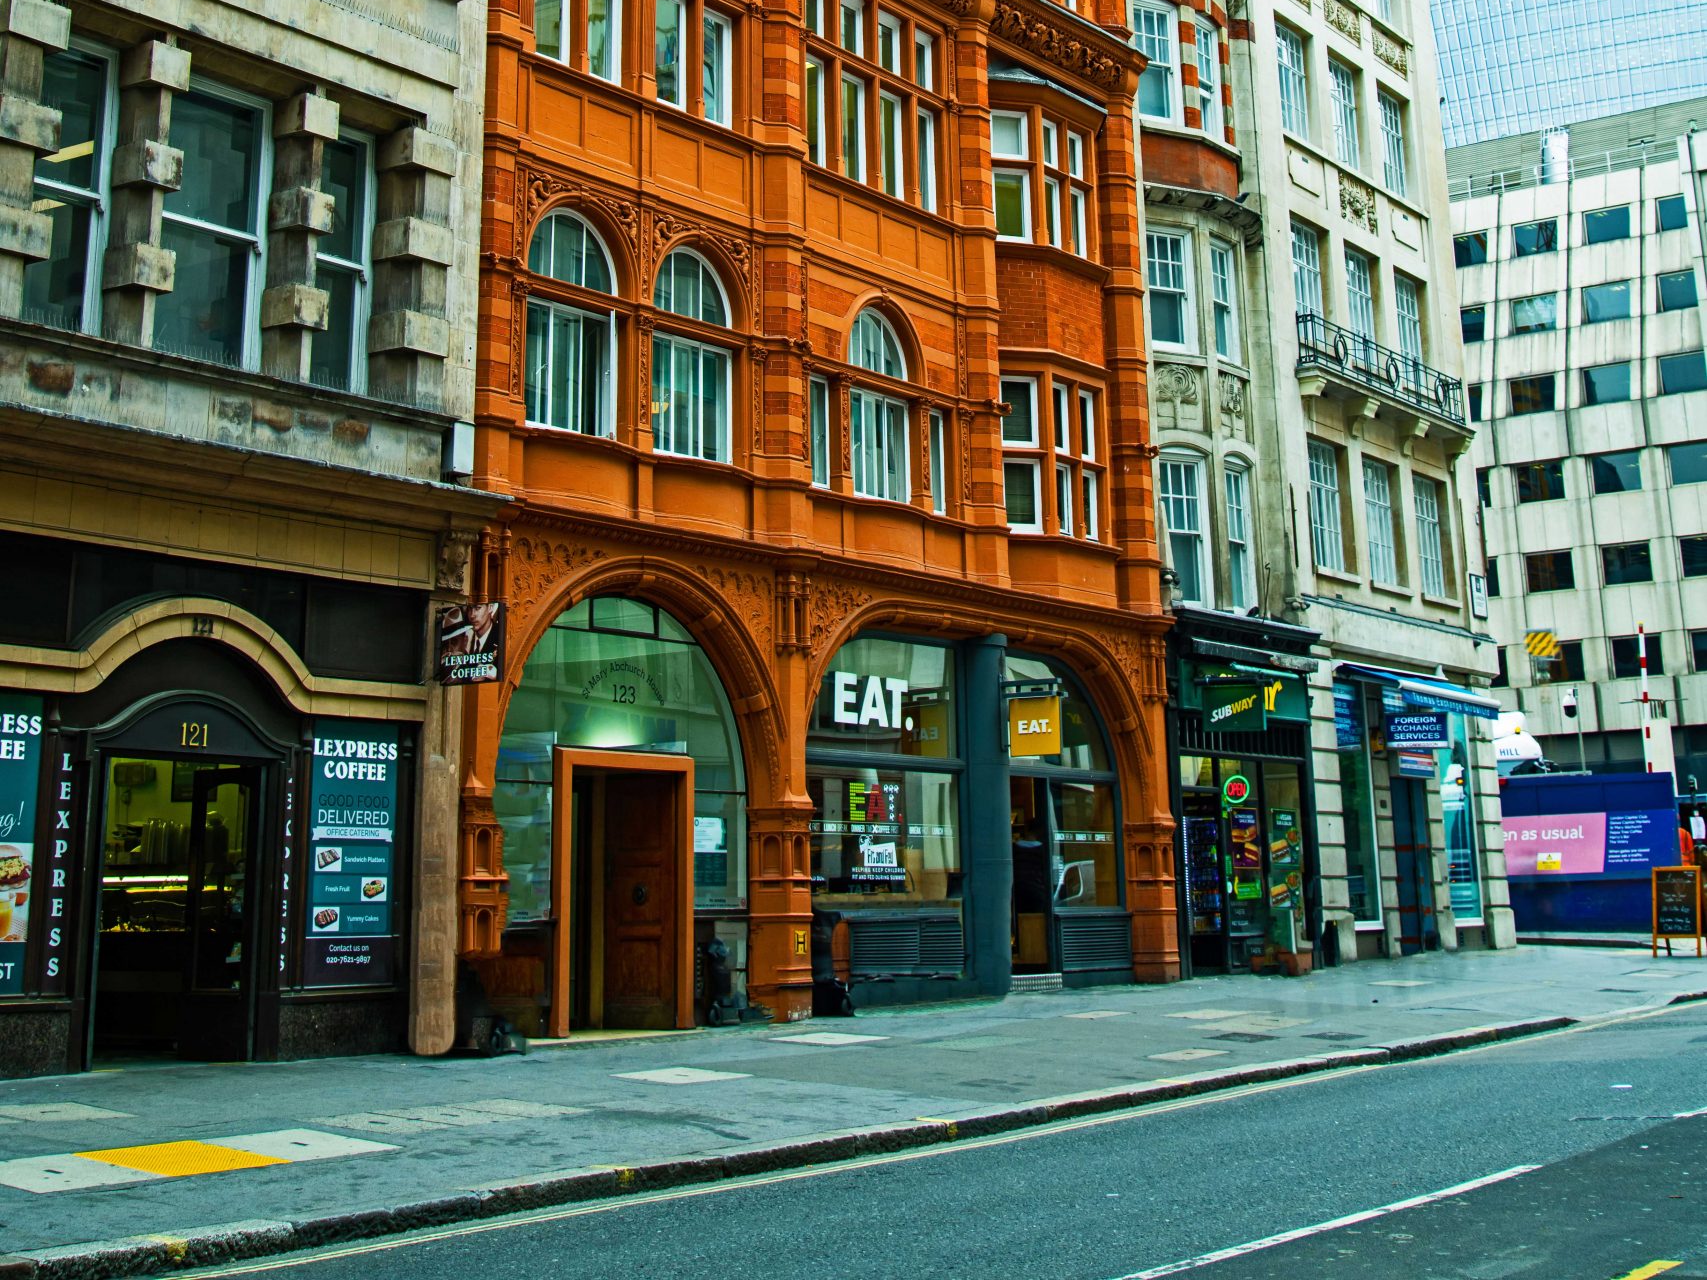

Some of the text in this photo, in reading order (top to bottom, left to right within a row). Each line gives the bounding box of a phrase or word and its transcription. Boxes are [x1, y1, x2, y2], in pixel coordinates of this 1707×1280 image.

[192, 617, 214, 635] 121
[445, 652, 494, 667] LEXPRESS
[451, 666, 488, 679] COFFEE
[588, 667, 608, 690] Mary
[610, 661, 646, 680] Abchurch
[612, 684, 636, 705] 123
[834, 671, 914, 731] EAT.
[1210, 694, 1257, 723] SUBWAY
[1017, 719, 1052, 735] EAT.
[1390, 724, 1442, 732] EXCHANGE
[1394, 716, 1437, 724] FOREIGN
[181, 722, 208, 747] 121
[1394, 732, 1440, 740] SERVICES
[313, 737, 398, 761] LEXPRESS
[1500, 748, 1520, 756] HILL
[323, 760, 387, 781] COFFEE
[1226, 782, 1246, 797] OPEN
[318, 793, 390, 809] GOOD FOOD
[317, 809, 390, 826] DELIVERED
[326, 828, 380, 837] OFFICE CATERING
[1521, 829, 1538, 841] as
[1541, 825, 1584, 840] usual
[46, 752, 73, 977] LEXPRESS
[346, 915, 364, 923] Yummy
[328, 944, 352, 952] Contact
[325, 955, 371, 964] 020-7621-9897
